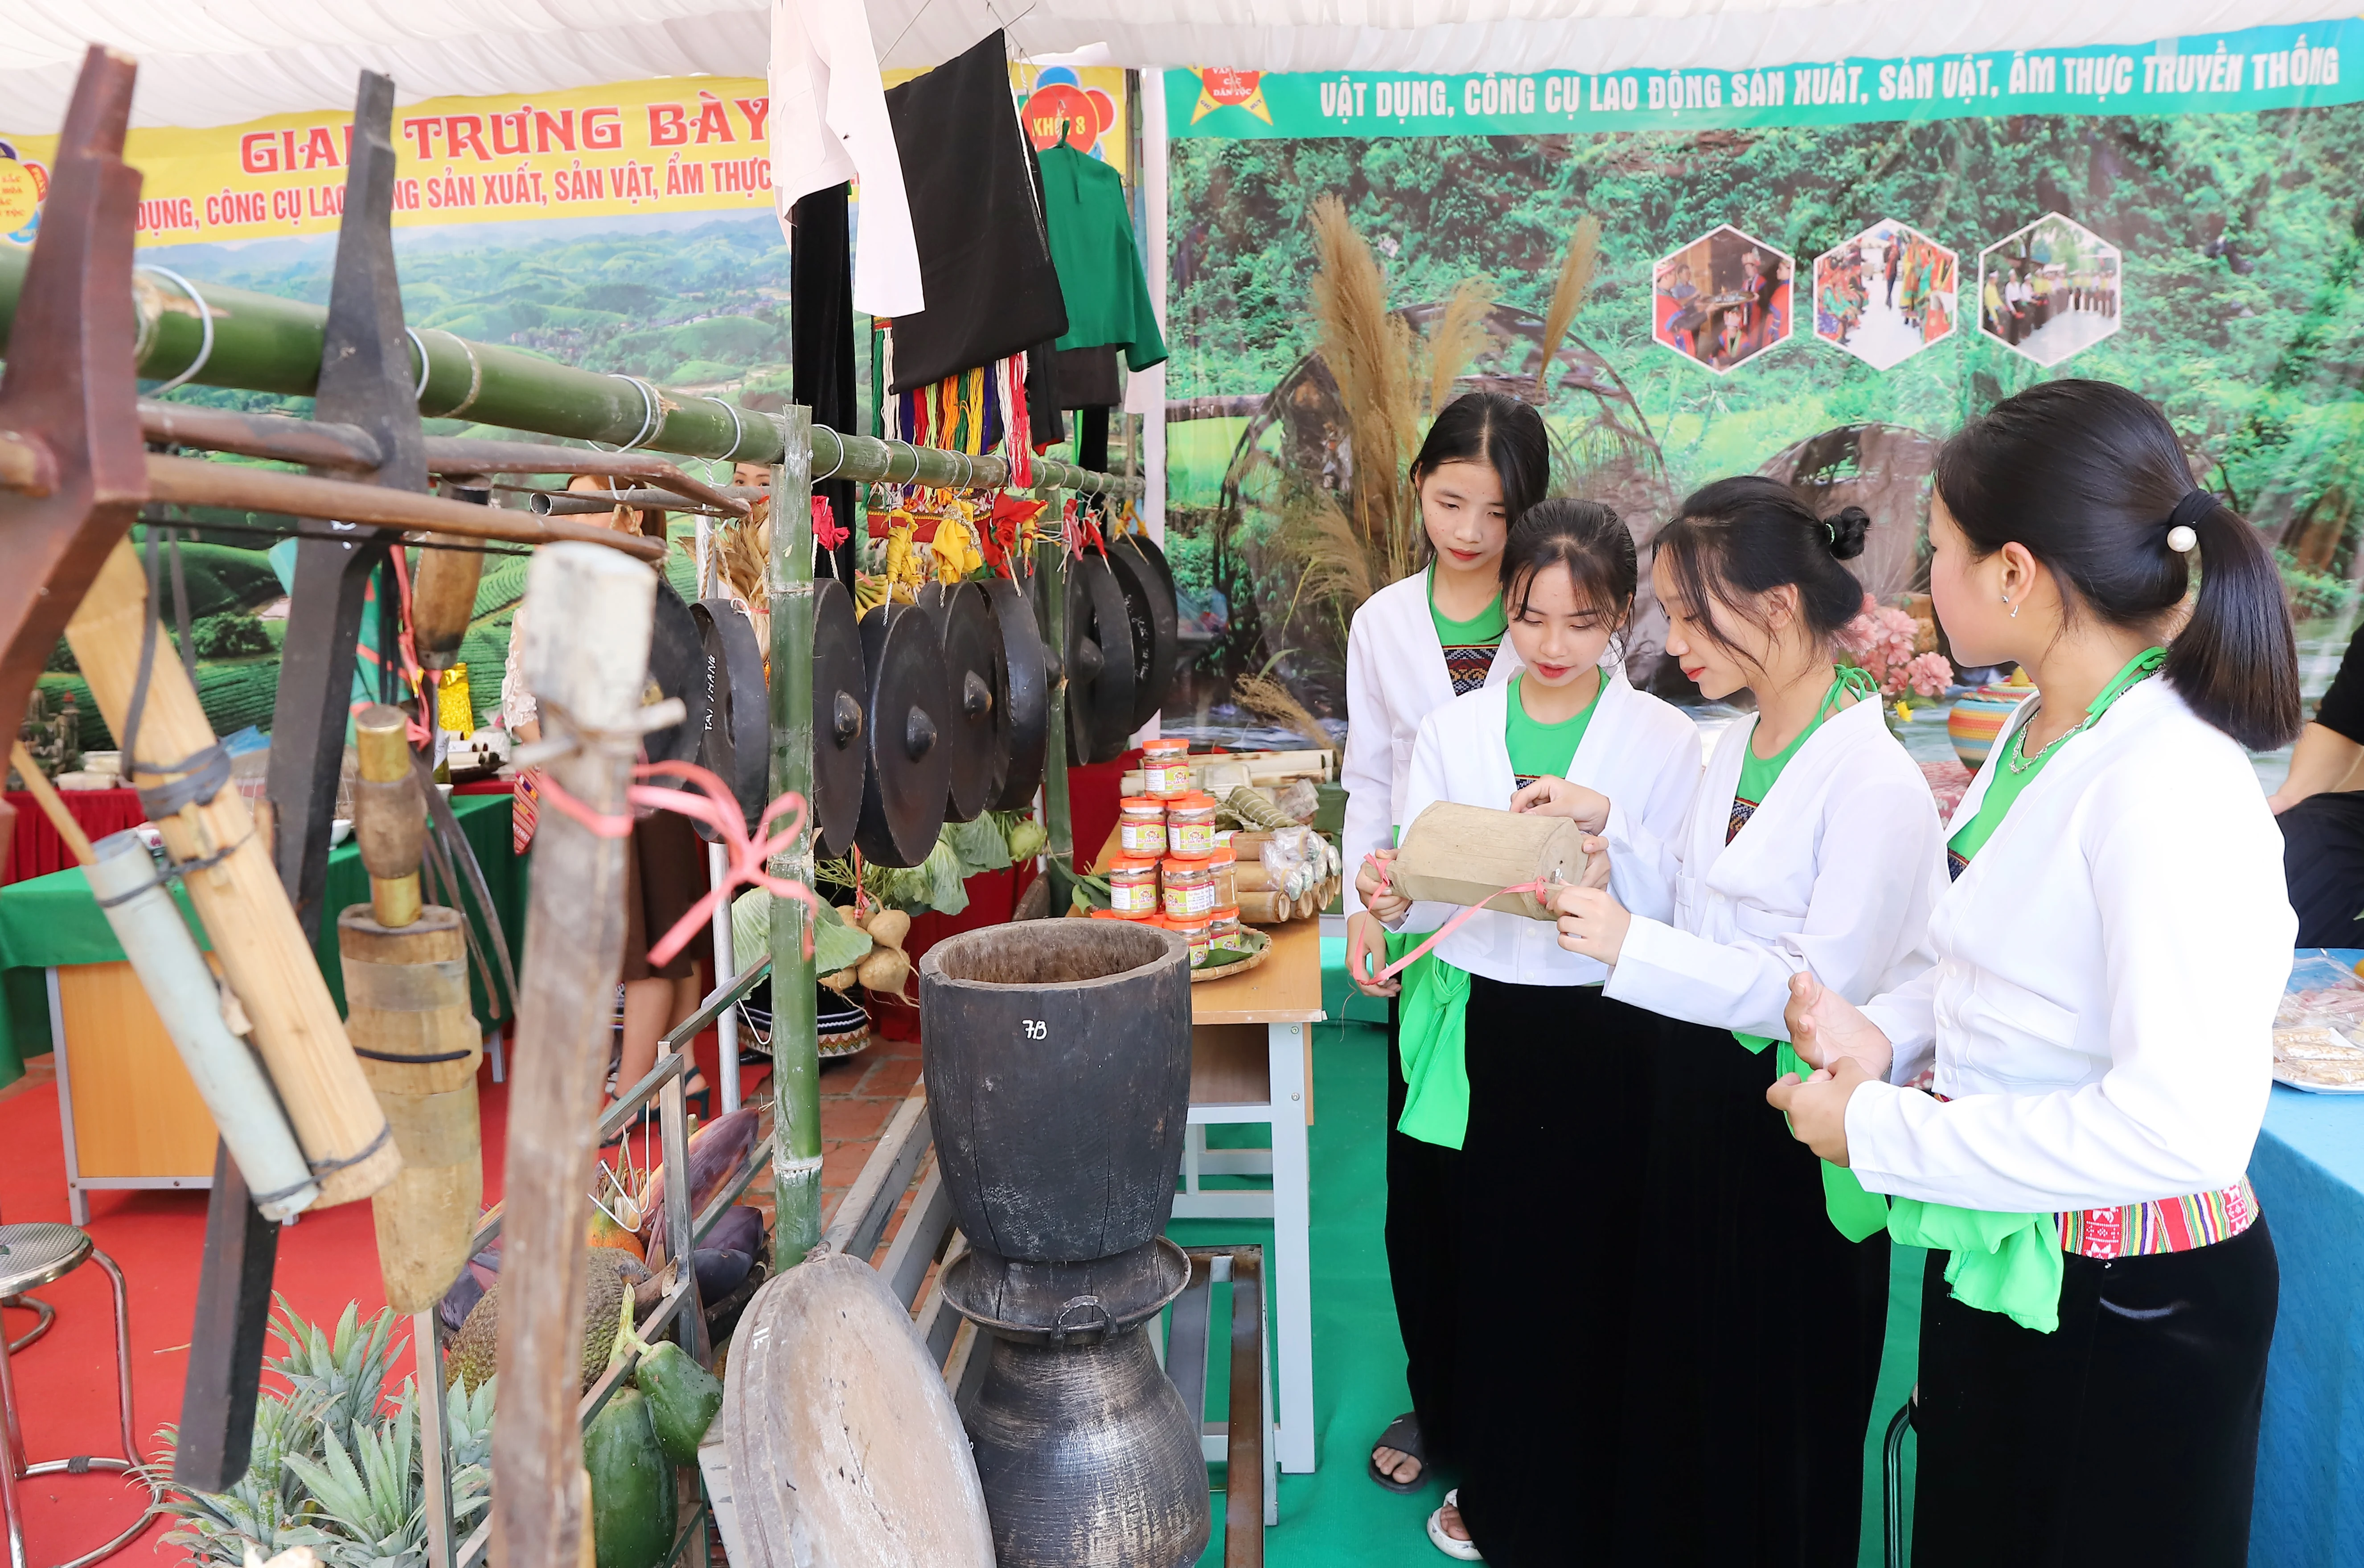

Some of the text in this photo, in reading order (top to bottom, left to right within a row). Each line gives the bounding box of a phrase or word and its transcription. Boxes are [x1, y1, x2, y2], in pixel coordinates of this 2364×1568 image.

[1223, 77, 1241, 85] CC
[1320, 75, 1367, 124] VẬT
[1375, 80, 1455, 124] DỤNG,
[1464, 72, 1535, 115] CÔNG
[1545, 76, 1580, 120] CỤ
[1590, 76, 1639, 111] LAO
[1648, 70, 1722, 117] ĐỘNG
[1941, 53, 1999, 104] VẬT,
[2062, 53, 2134, 103] THỰC
[2142, 40, 2245, 94] TRUYỀN
[2251, 33, 2339, 90] THỐNG
[241, 91, 769, 173] GIA TRƯNG BÀY
[1075, 115, 1085, 135] 8
[136, 197, 199, 236] DỤNG,
[206, 188, 265, 225] CÔNG
[273, 189, 301, 226] CỤ
[391, 179, 420, 210] NG
[427, 167, 476, 208] SẢN
[483, 161, 547, 206] XUẤT,
[554, 160, 604, 201] SẢN
[610, 160, 658, 204] VẬT,
[667, 152, 704, 195] ẨM
[711, 157, 772, 197] THỰC
